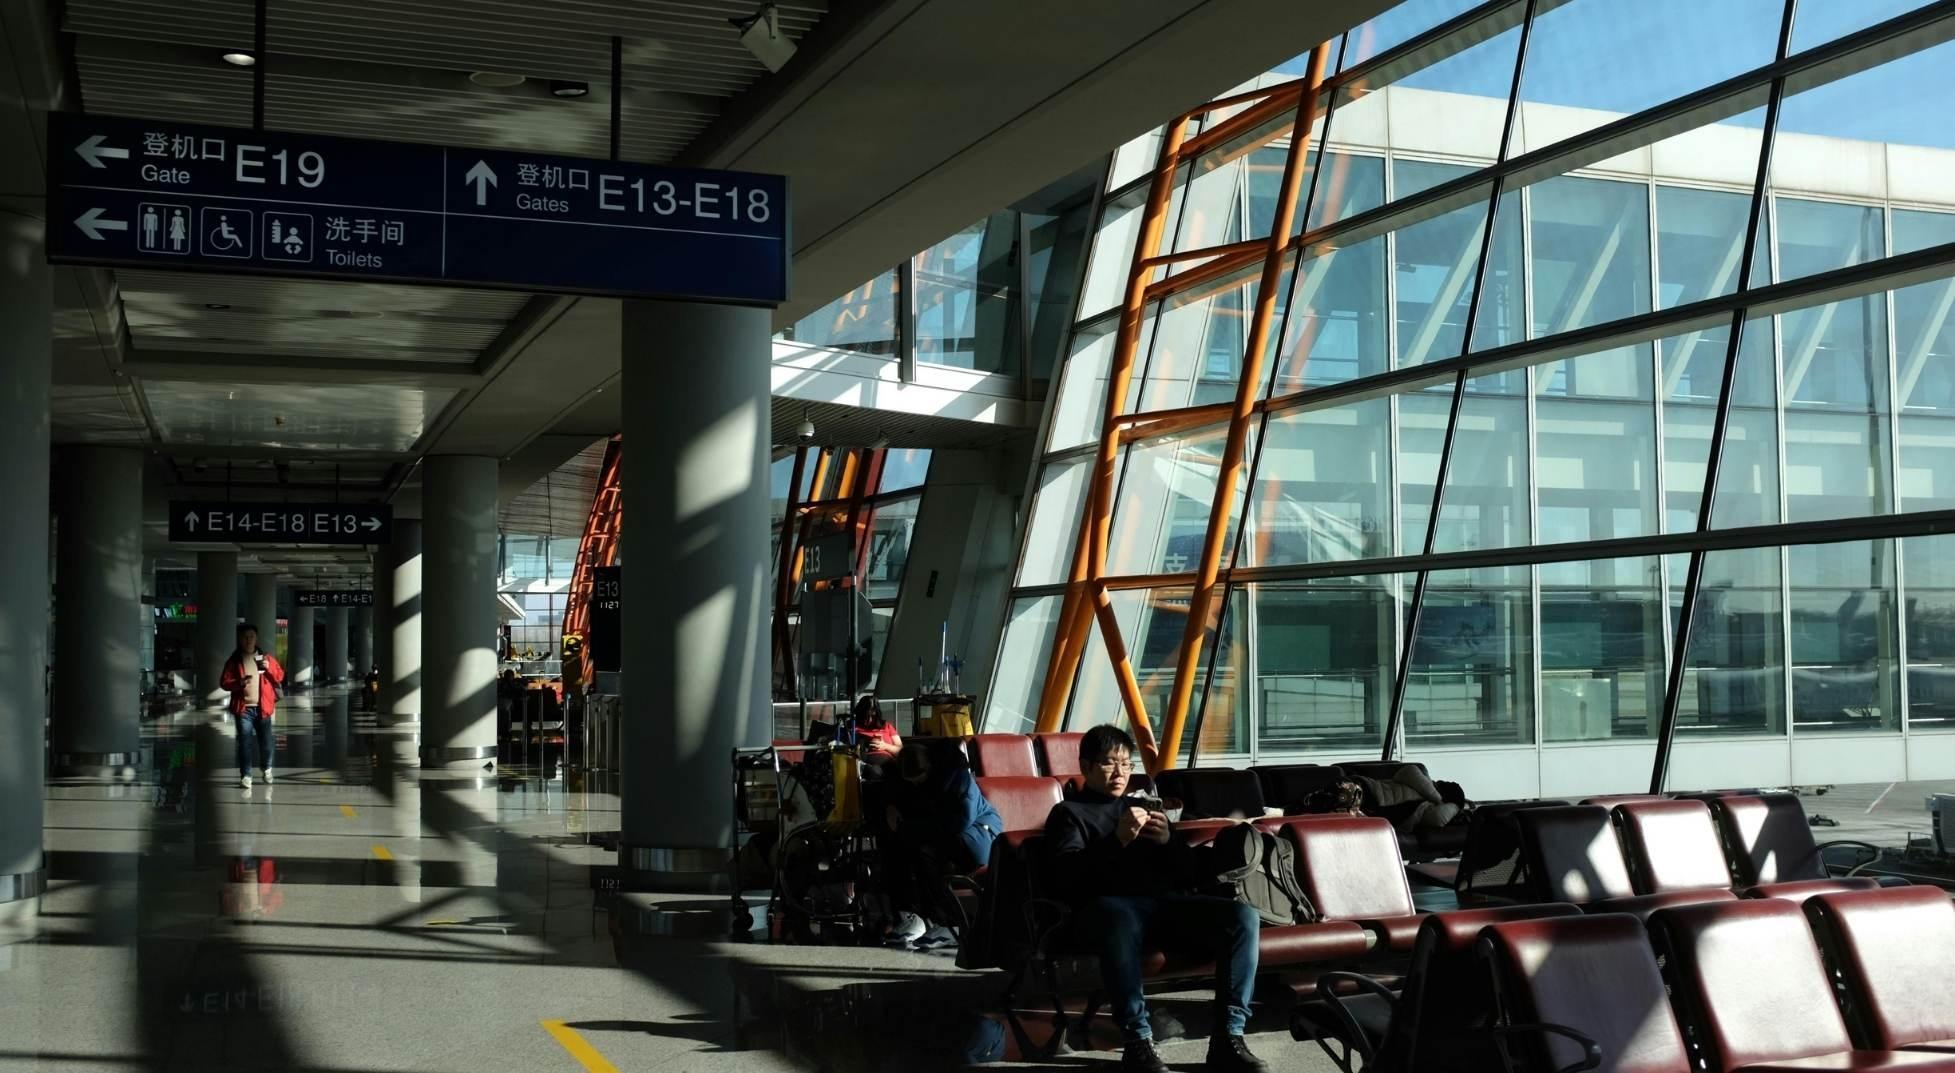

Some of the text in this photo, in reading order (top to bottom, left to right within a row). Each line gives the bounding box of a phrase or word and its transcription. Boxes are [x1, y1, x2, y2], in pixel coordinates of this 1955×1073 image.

[142, 131, 226, 163] 登机口
[141, 163, 191, 185] Gate
[235, 143, 326, 188] E19
[516, 163, 590, 191] 登机口
[516, 193, 570, 214] Gates
[599, 173, 770, 224] E13-E18
[325, 215, 405, 246] 洗手间
[325, 249, 383, 269] Toilets
[207, 511, 305, 533] E14-E18
[314, 513, 357, 534] E13
[803, 545, 821, 575] E13
[597, 580, 619, 597] E13
